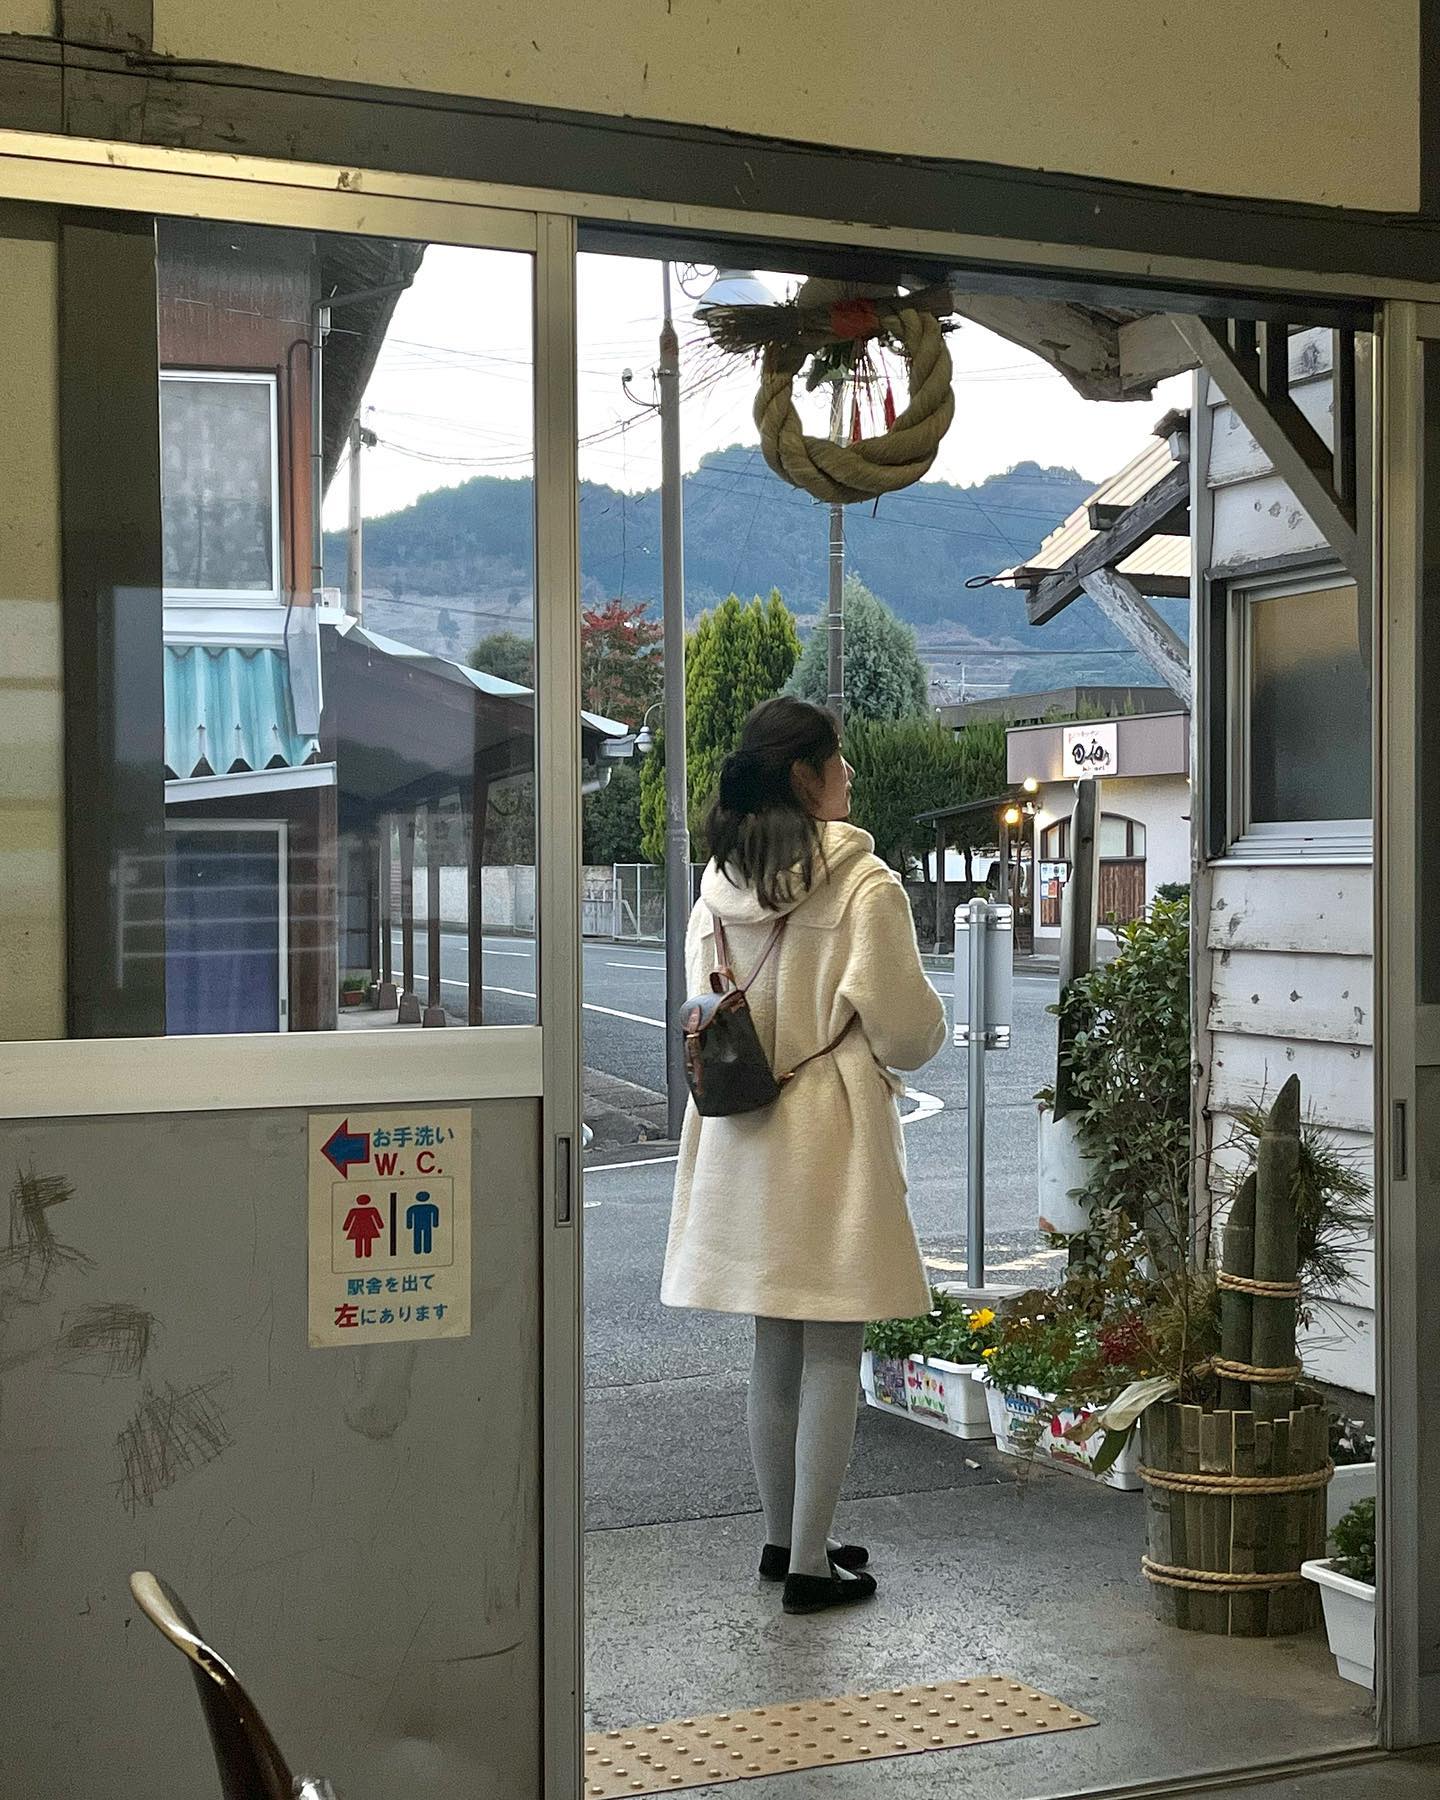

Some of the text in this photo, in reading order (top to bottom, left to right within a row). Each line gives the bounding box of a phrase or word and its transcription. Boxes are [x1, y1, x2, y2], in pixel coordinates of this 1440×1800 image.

[373, 1125, 454, 1147] お手洗い
[347, 1274, 435, 1296] 駅舎を出て
[334, 1303, 448, 1328] 左にあります
